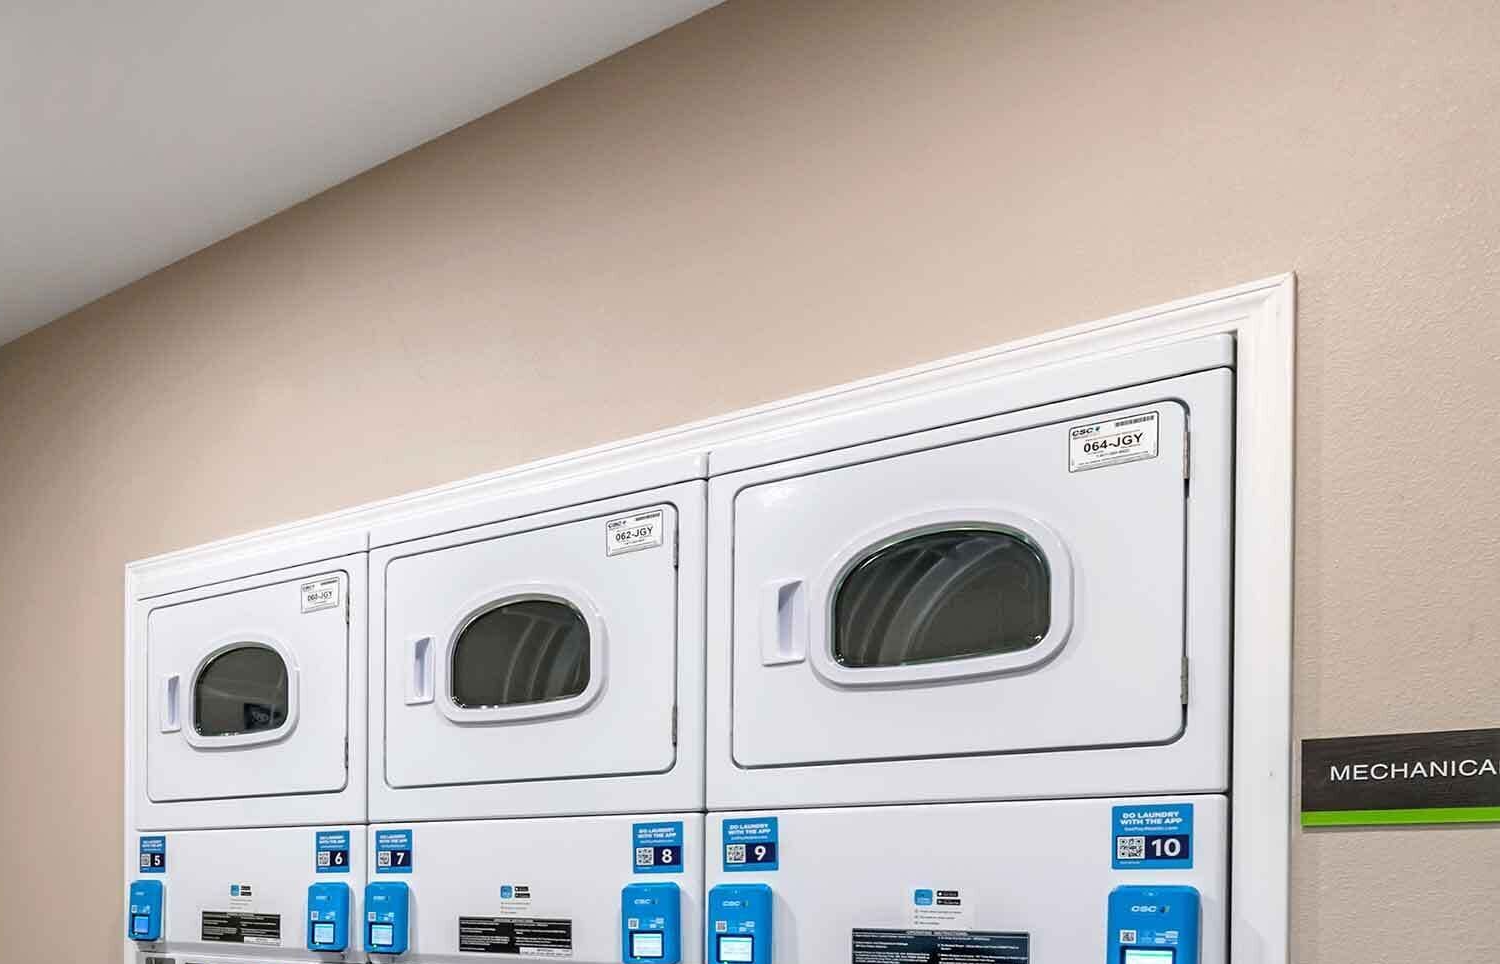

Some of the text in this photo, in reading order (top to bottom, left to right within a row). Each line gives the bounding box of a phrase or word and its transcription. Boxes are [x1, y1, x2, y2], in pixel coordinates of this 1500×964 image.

[1083, 432, 1145, 453] 064-JGY
[615, 525, 653, 542] 062-JGY
[1330, 759, 1500, 781] MECHANICA
[1137, 810, 1180, 818] LAUNDRY
[754, 845, 766, 861] 9
[1151, 838, 1181, 857] 10
[154, 855, 161, 866] 5
[334, 852, 343, 865] 6
[396, 852, 405, 865] 7
[661, 848, 673, 864] 8
